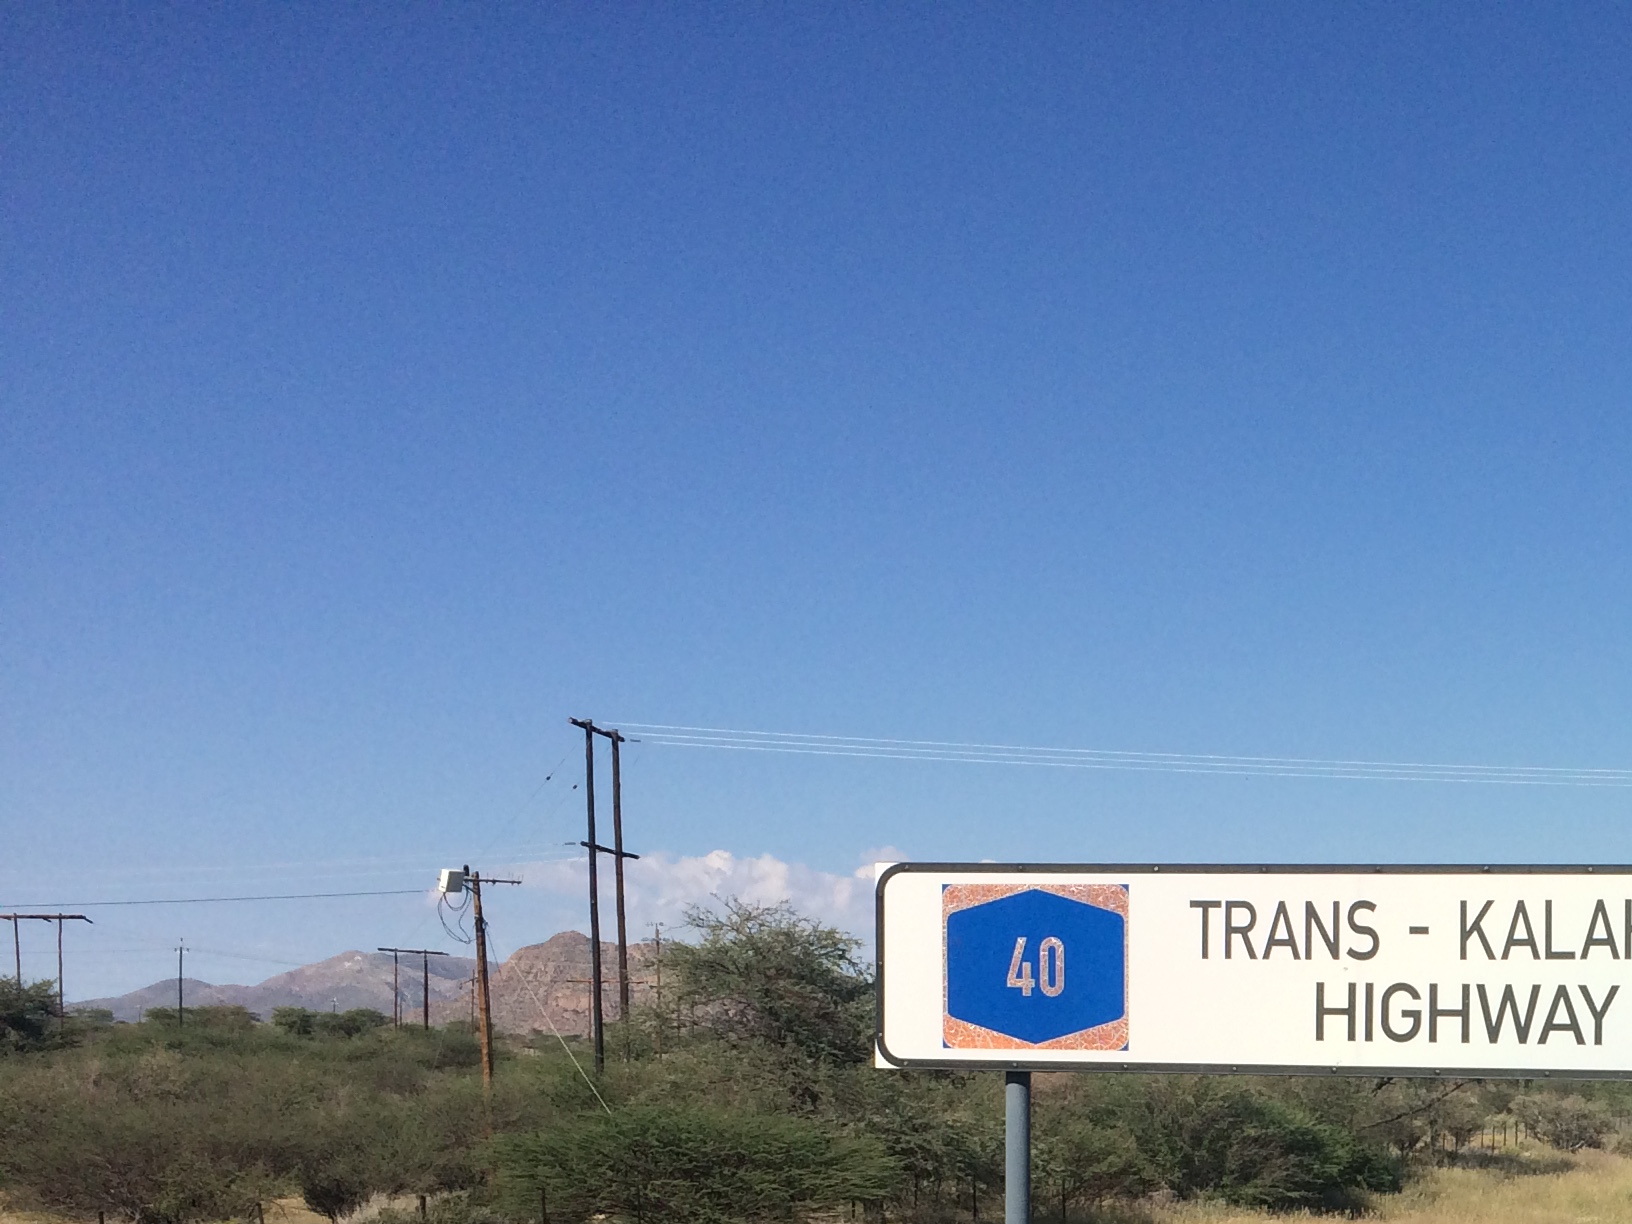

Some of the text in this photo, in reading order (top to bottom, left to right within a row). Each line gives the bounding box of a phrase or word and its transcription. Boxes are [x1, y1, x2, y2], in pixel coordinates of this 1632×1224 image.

[1189, 900, 1380, 961] TRANS
[1409, 925, 1430, 936] -
[1006, 936, 1065, 997] 40
[1315, 982, 1621, 1046] HIGHWAY
